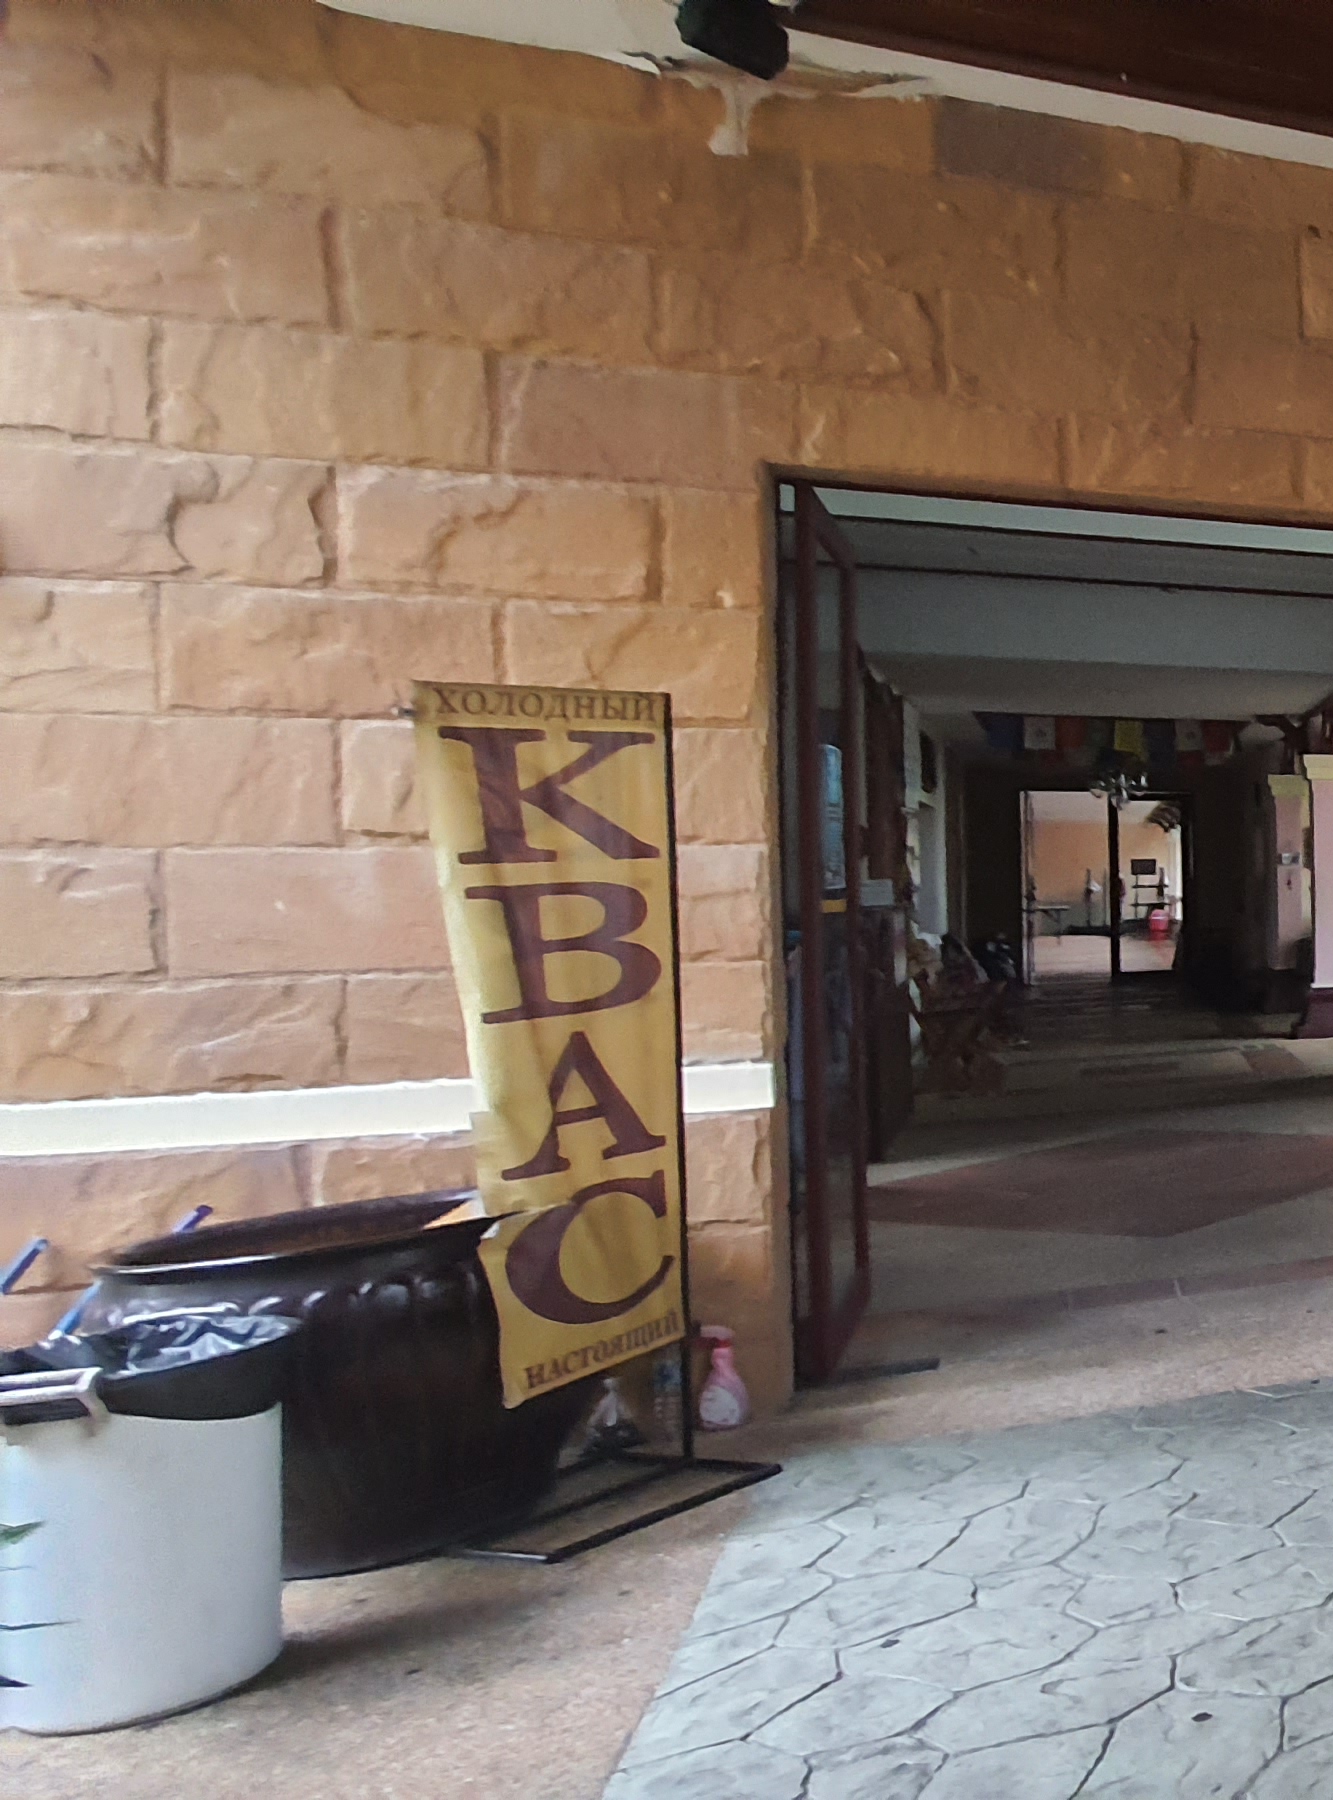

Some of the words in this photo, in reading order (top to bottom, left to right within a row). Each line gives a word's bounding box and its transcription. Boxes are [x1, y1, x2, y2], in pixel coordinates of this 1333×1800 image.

[432, 687, 657, 723] ХОЛОДНЫЙ
[437, 725, 674, 1325] КВАС
[525, 1308, 680, 1389] НАСТОЯЩИЙ
